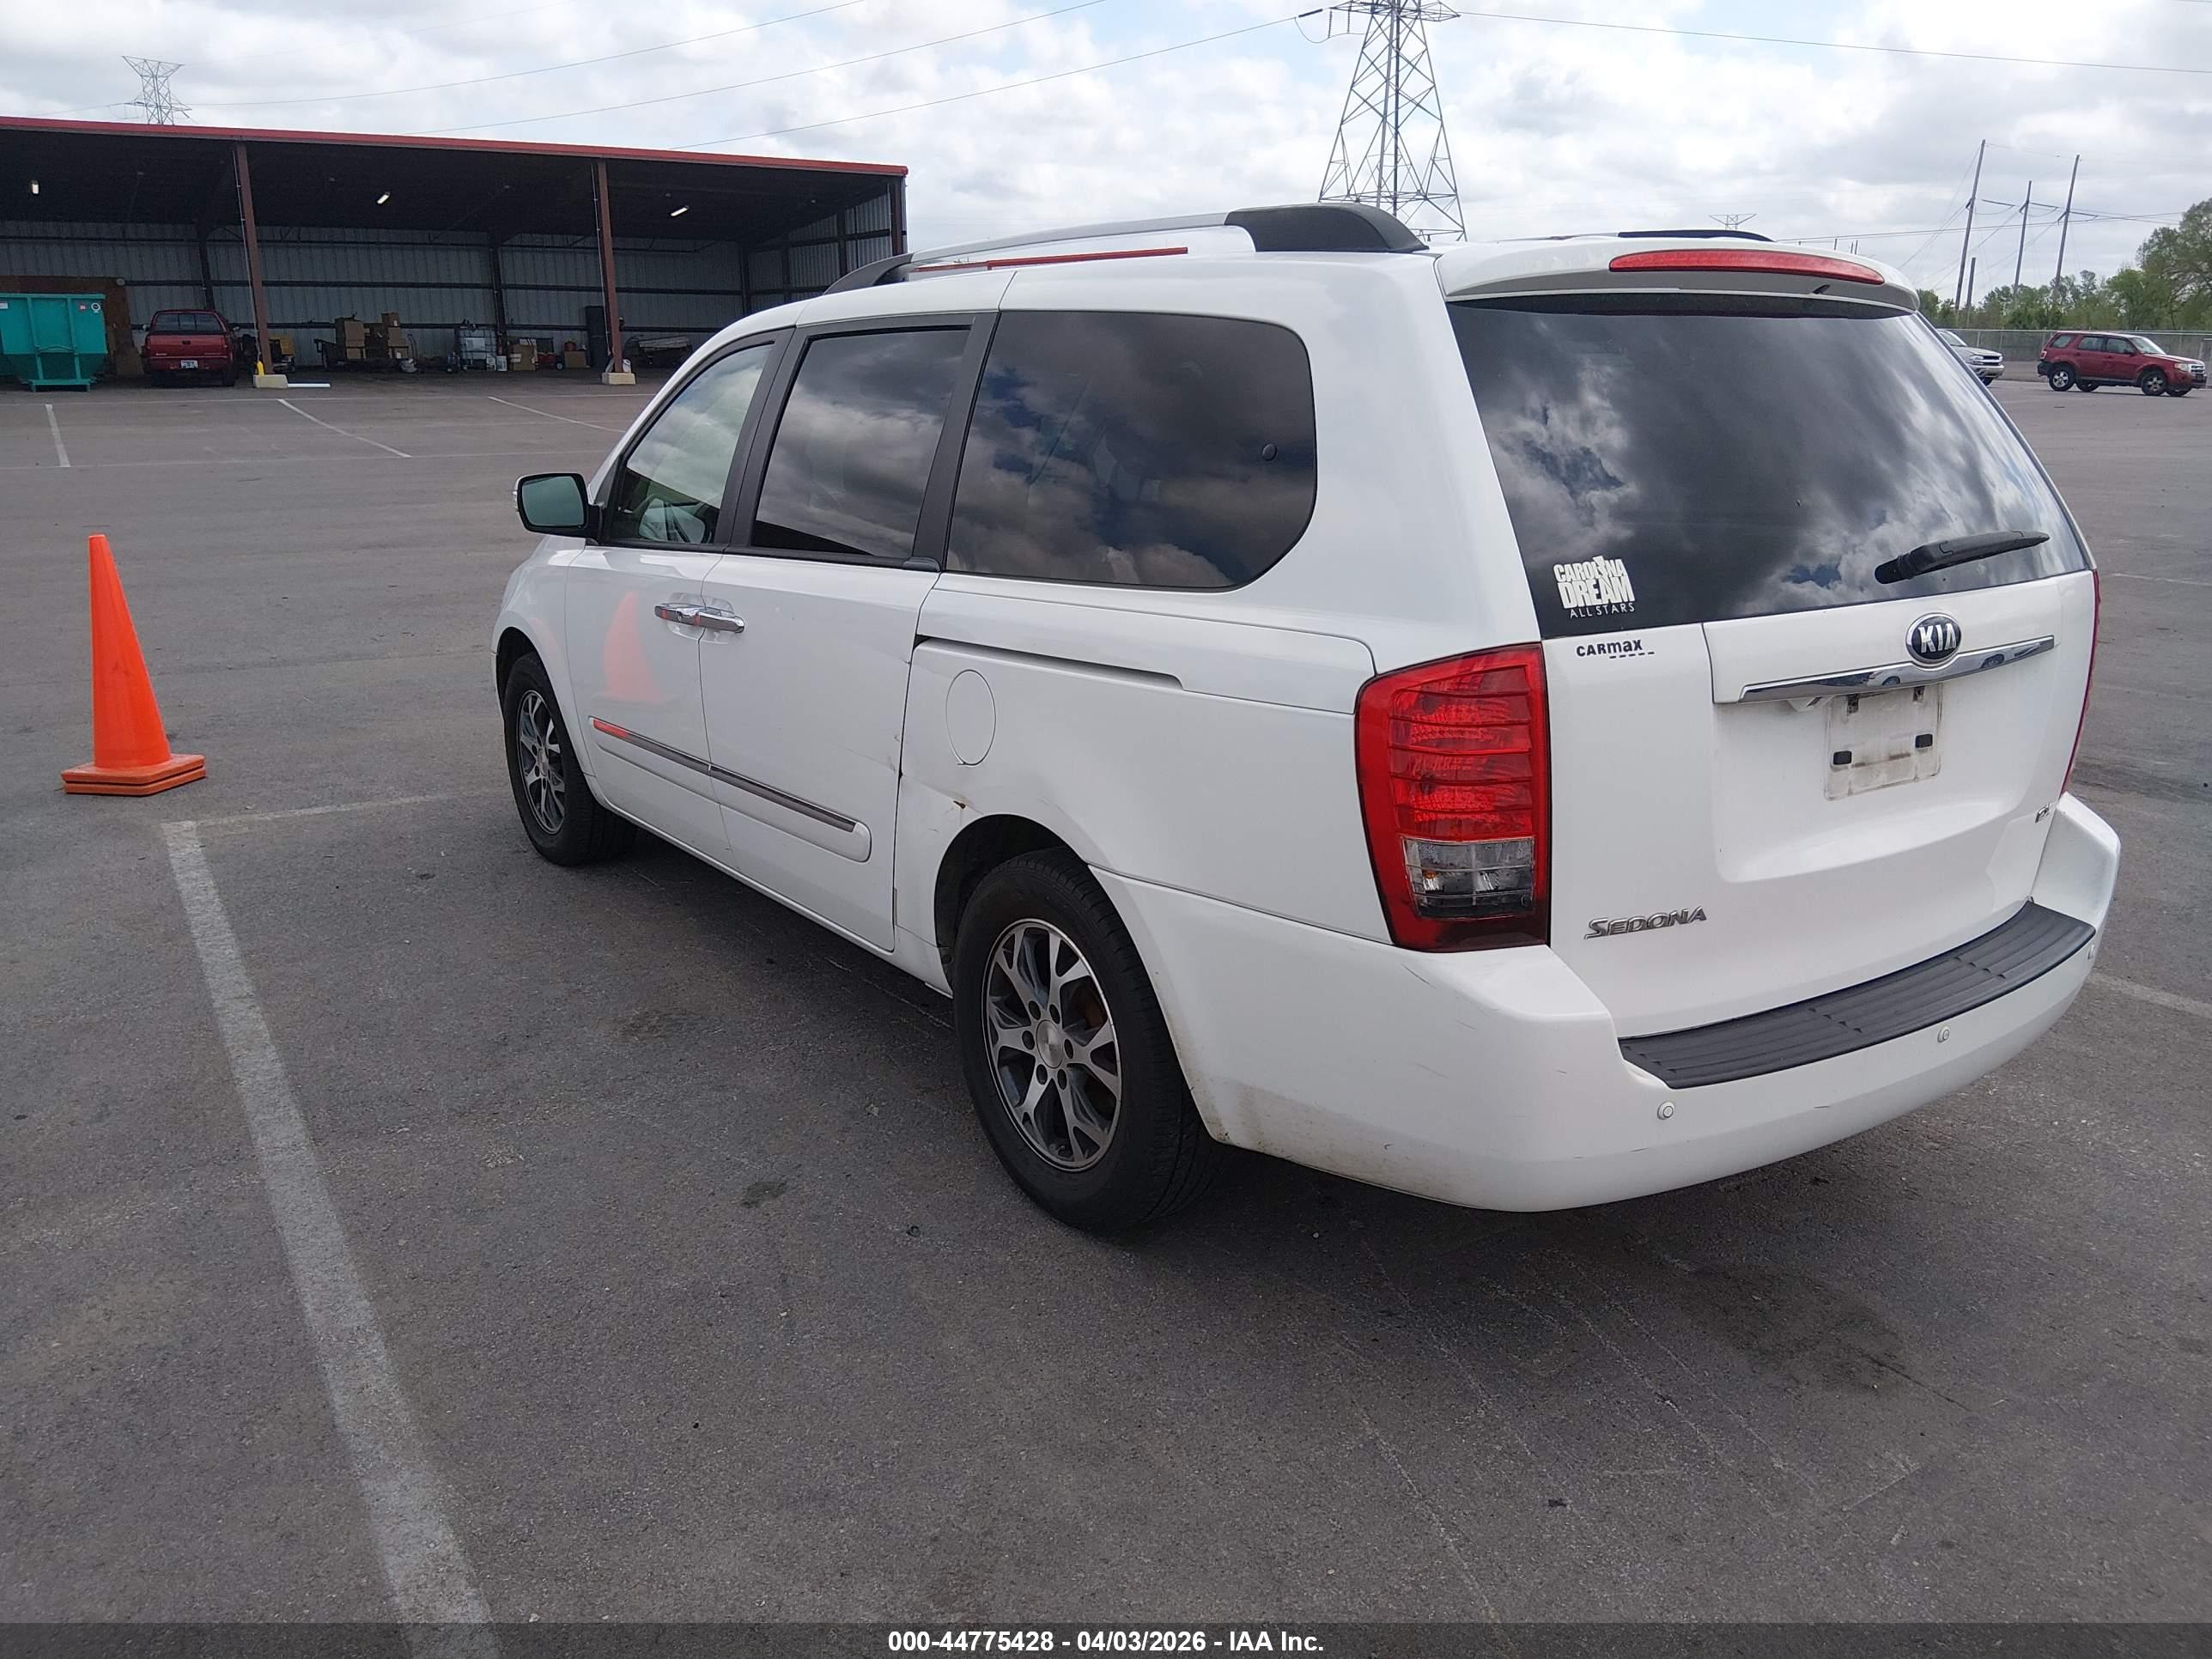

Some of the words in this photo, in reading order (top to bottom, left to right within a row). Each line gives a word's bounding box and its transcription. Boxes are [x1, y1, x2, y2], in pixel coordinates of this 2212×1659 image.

[1558, 575, 1636, 609] DREAM
[1570, 606, 1593, 619] ALL
[1595, 602, 1635, 616] STARS
[1917, 623, 1957, 653] KIA
[1583, 906, 1707, 939] SEDONA
